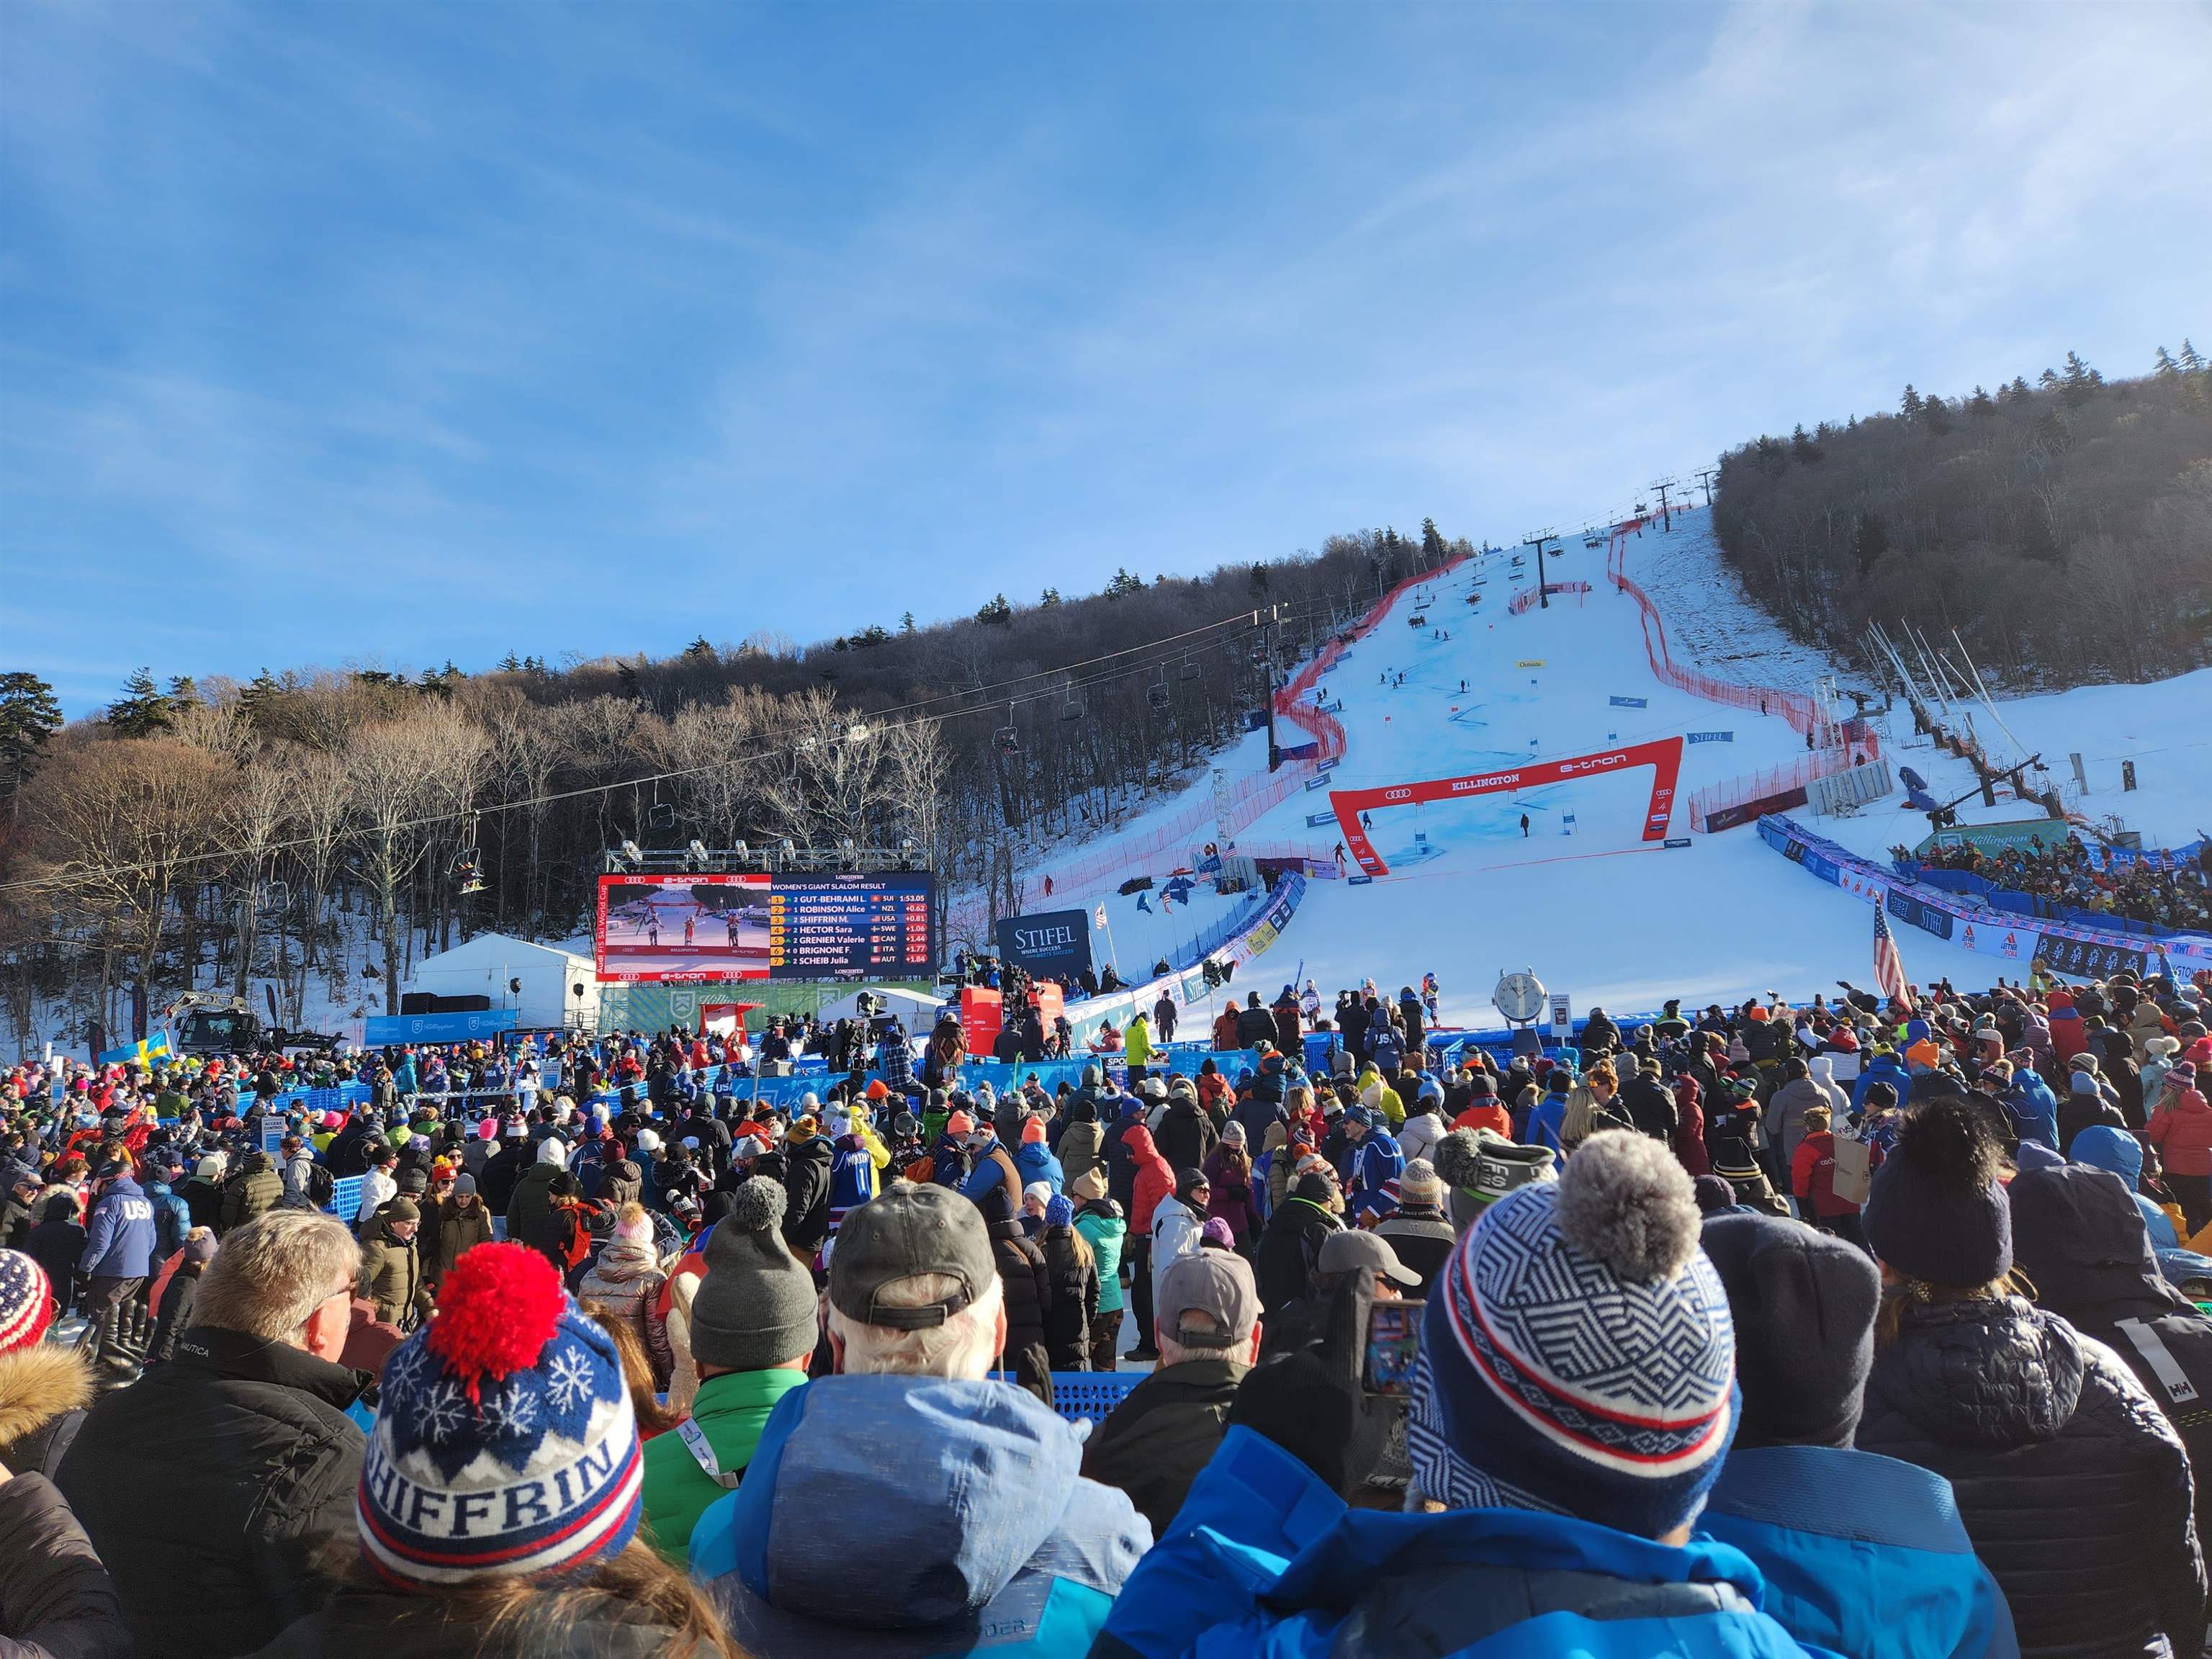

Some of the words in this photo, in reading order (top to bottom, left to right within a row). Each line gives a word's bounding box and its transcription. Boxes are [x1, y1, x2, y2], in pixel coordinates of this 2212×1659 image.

[1694, 733, 1725, 742] STIFEL
[1560, 754, 1626, 773] e-tron
[1452, 774, 1519, 791] KILLINGTON
[1920, 907, 1943, 935] STIFEL
[1015, 926, 1077, 950] STIFEL
[2176, 943, 2190, 954] BWT
[699, 994, 761, 1004] Killington
[859, 1168, 866, 1191] 1
[2168, 1381, 2193, 1397] HH
[367, 1439, 615, 1537] HIFFRIN
